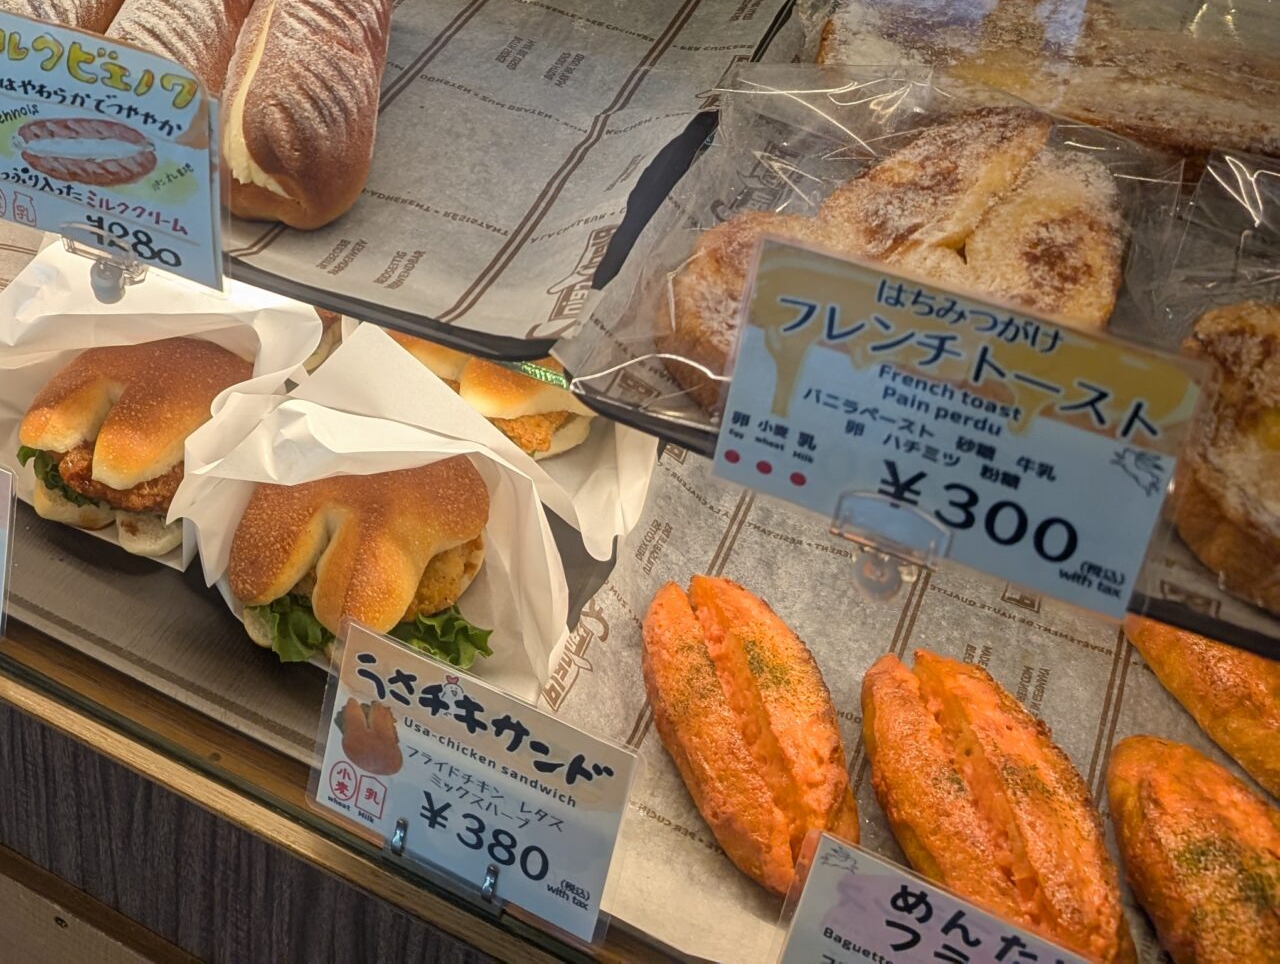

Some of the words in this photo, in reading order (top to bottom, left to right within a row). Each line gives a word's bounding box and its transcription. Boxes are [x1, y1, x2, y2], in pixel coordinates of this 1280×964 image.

[875, 277, 1065, 355] はちみつがけ
[777, 295, 1163, 440] フレンチトースト
[877, 363, 956, 402] French
[958, 385, 1024, 424] toast
[731, 411, 751, 429] 卵
[758, 418, 789, 441] 小麦
[797, 431, 817, 452] 乳
[803, 387, 936, 439] バニラペースト
[955, 435, 998, 462] 砂糖
[1015, 454, 1058, 483] 牛乳
[881, 386, 932, 414] Pain
[934, 398, 1003, 438] perdu
[754, 436, 786, 453] wheat
[845, 419, 865, 438] 卵
[883, 430, 963, 469] ハチミツ
[979, 466, 1022, 491] 粉糖
[878, 457, 1079, 565] ¥300
[1058, 566, 1095, 591] with
[1097, 579, 1122, 598] tax
[357, 653, 614, 786] うさチキサンド
[335, 767, 352, 797] 小麦
[403, 715, 498, 770] Usa-chicken
[500, 764, 578, 809] sandwich
[406, 744, 505, 800] フライドチキン
[519, 800, 565, 833] レタス
[327, 795, 352, 812] wheat
[357, 810, 375, 824] Milk
[365, 787, 381, 805] 乳
[430, 772, 531, 830] ミックスハーブ
[420, 790, 550, 882] ¥380
[546, 884, 573, 903] with
[571, 897, 590, 911] tax
[559, 879, 591, 902] (税込)
